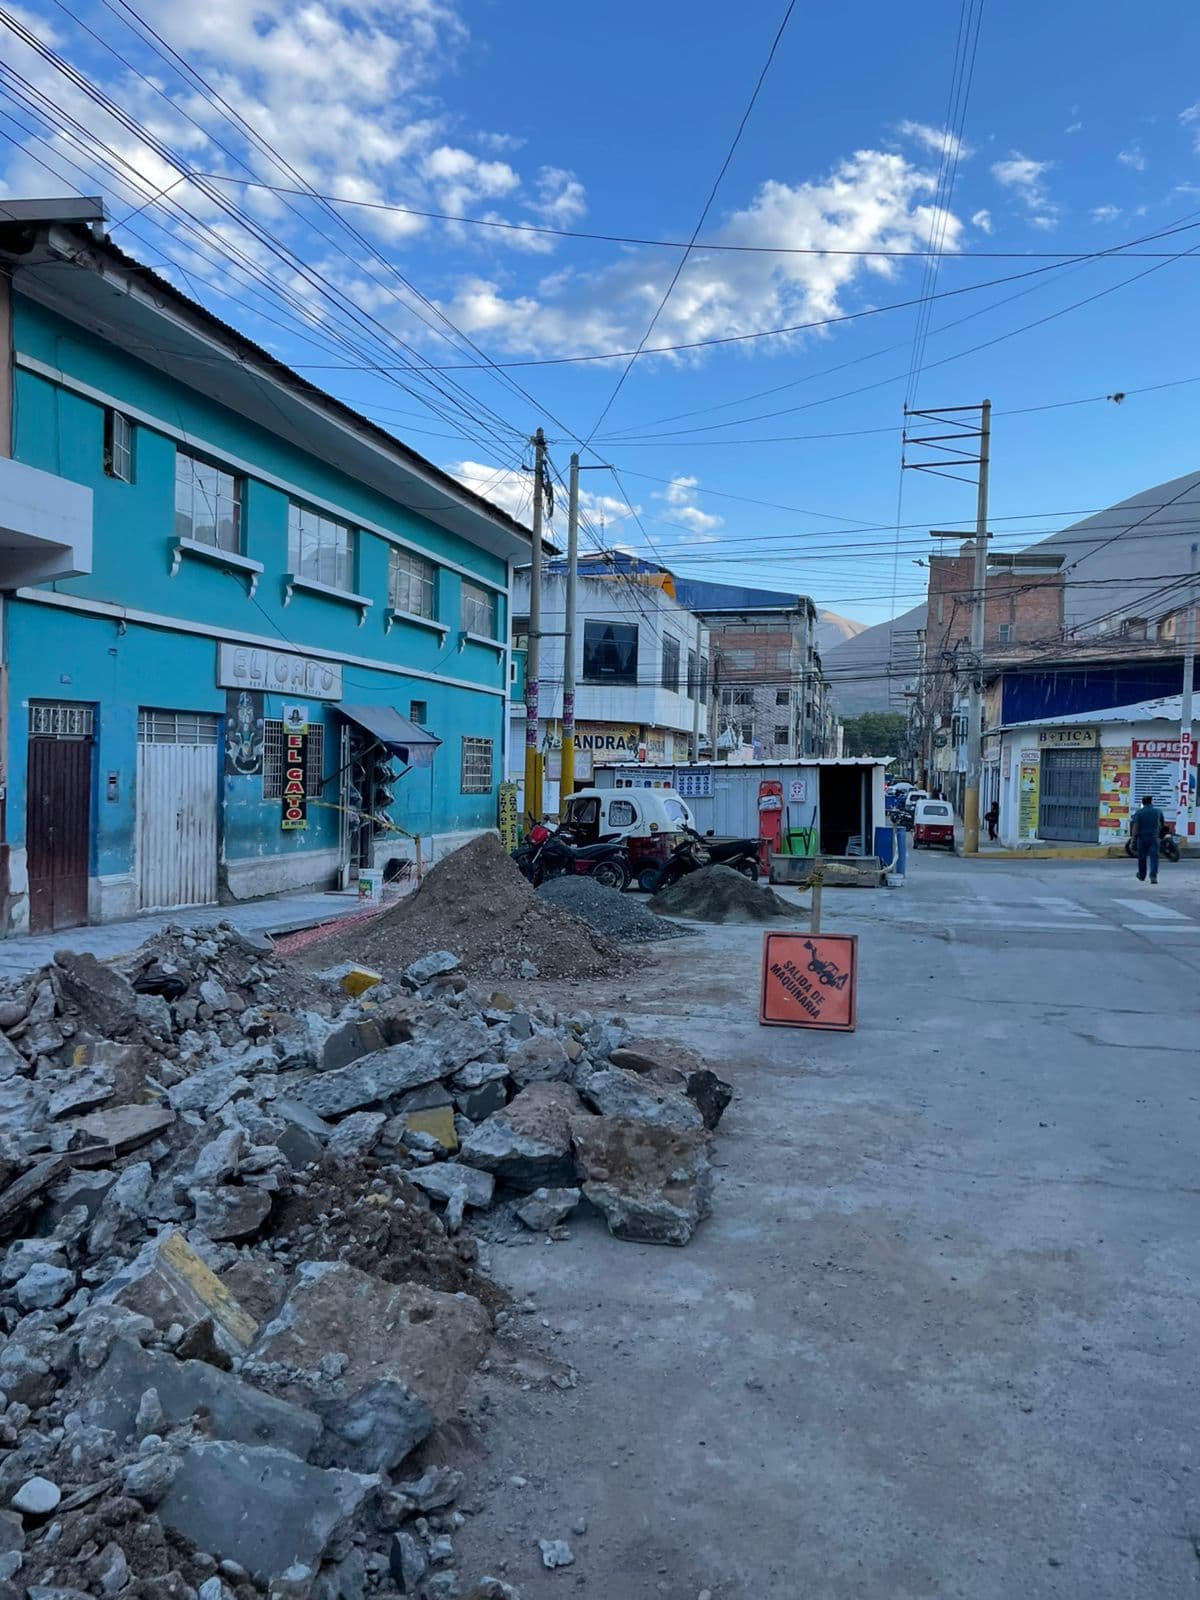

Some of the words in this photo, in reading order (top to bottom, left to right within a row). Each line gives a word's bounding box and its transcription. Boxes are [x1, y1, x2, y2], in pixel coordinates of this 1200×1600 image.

[233, 648, 261, 680] EL
[274, 654, 333, 691] GATO
[287, 735, 302, 763] EL
[1179, 733, 1190, 807] BOTICA
[285, 768, 305, 820] GATO
[770, 963, 821, 1019] MAQUINARIA
[782, 960, 811, 993] SALIDA
[811, 990, 825, 1006] DE
